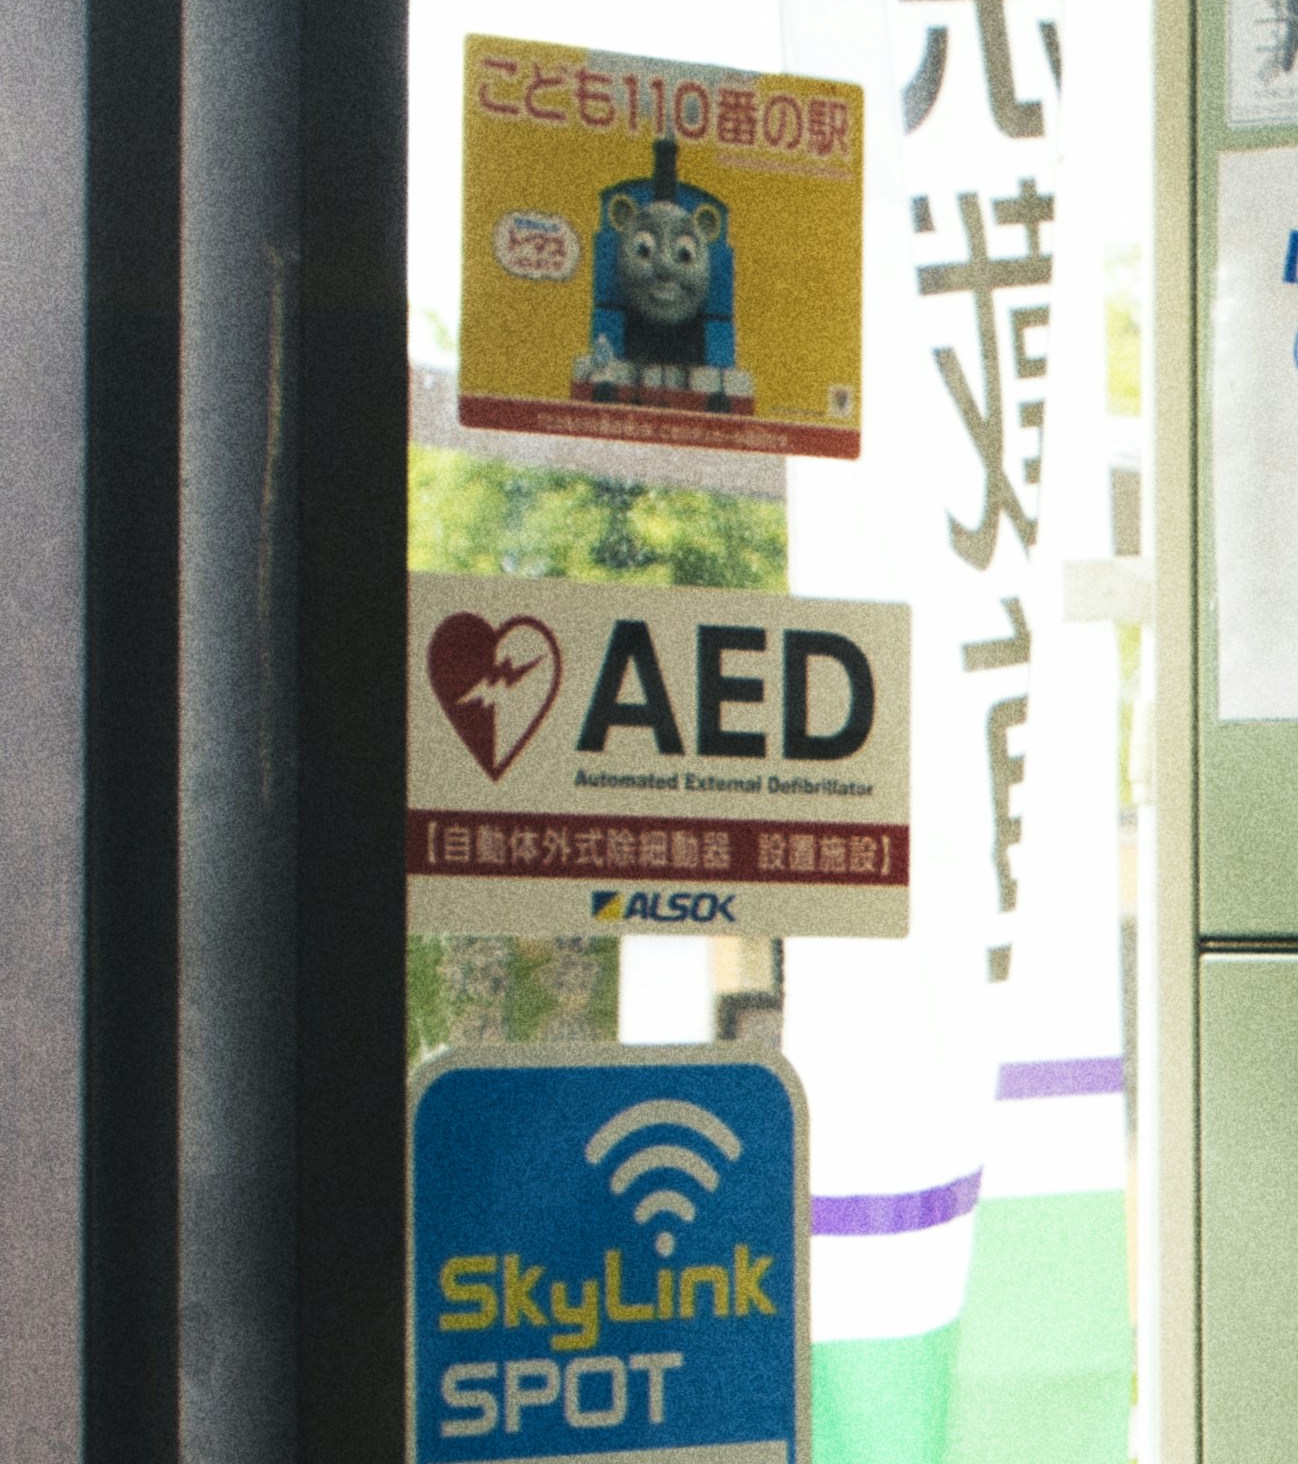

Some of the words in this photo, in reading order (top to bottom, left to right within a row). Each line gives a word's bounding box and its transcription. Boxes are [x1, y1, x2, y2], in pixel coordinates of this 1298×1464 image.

[478, 57, 851, 158] こども110番の駅
[574, 616, 877, 762] AED
[574, 769, 679, 790] Automated
[684, 773, 762, 793] External
[767, 776, 874, 796] Defibrillator
[624, 890, 737, 923] ALSOK
[437, 1243, 777, 1352] SkyLink
[440, 1352, 684, 1439] SPOT
